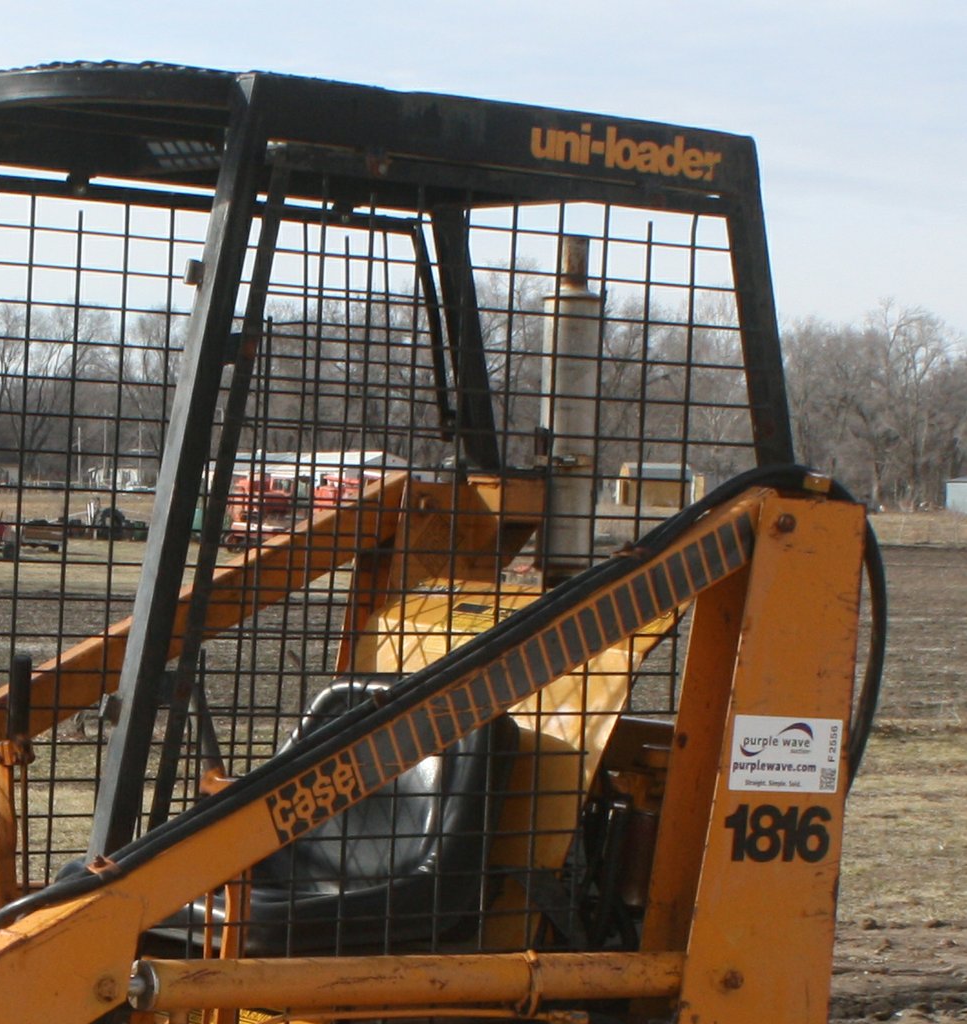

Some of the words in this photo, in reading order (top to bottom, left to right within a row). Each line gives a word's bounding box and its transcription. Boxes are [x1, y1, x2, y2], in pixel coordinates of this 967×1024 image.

[530, 122, 722, 182] uni-loader
[743, 735, 779, 750] purple
[782, 737, 811, 748] wave
[732, 760, 817, 773] purplewave.com
[724, 803, 832, 863] 1816
